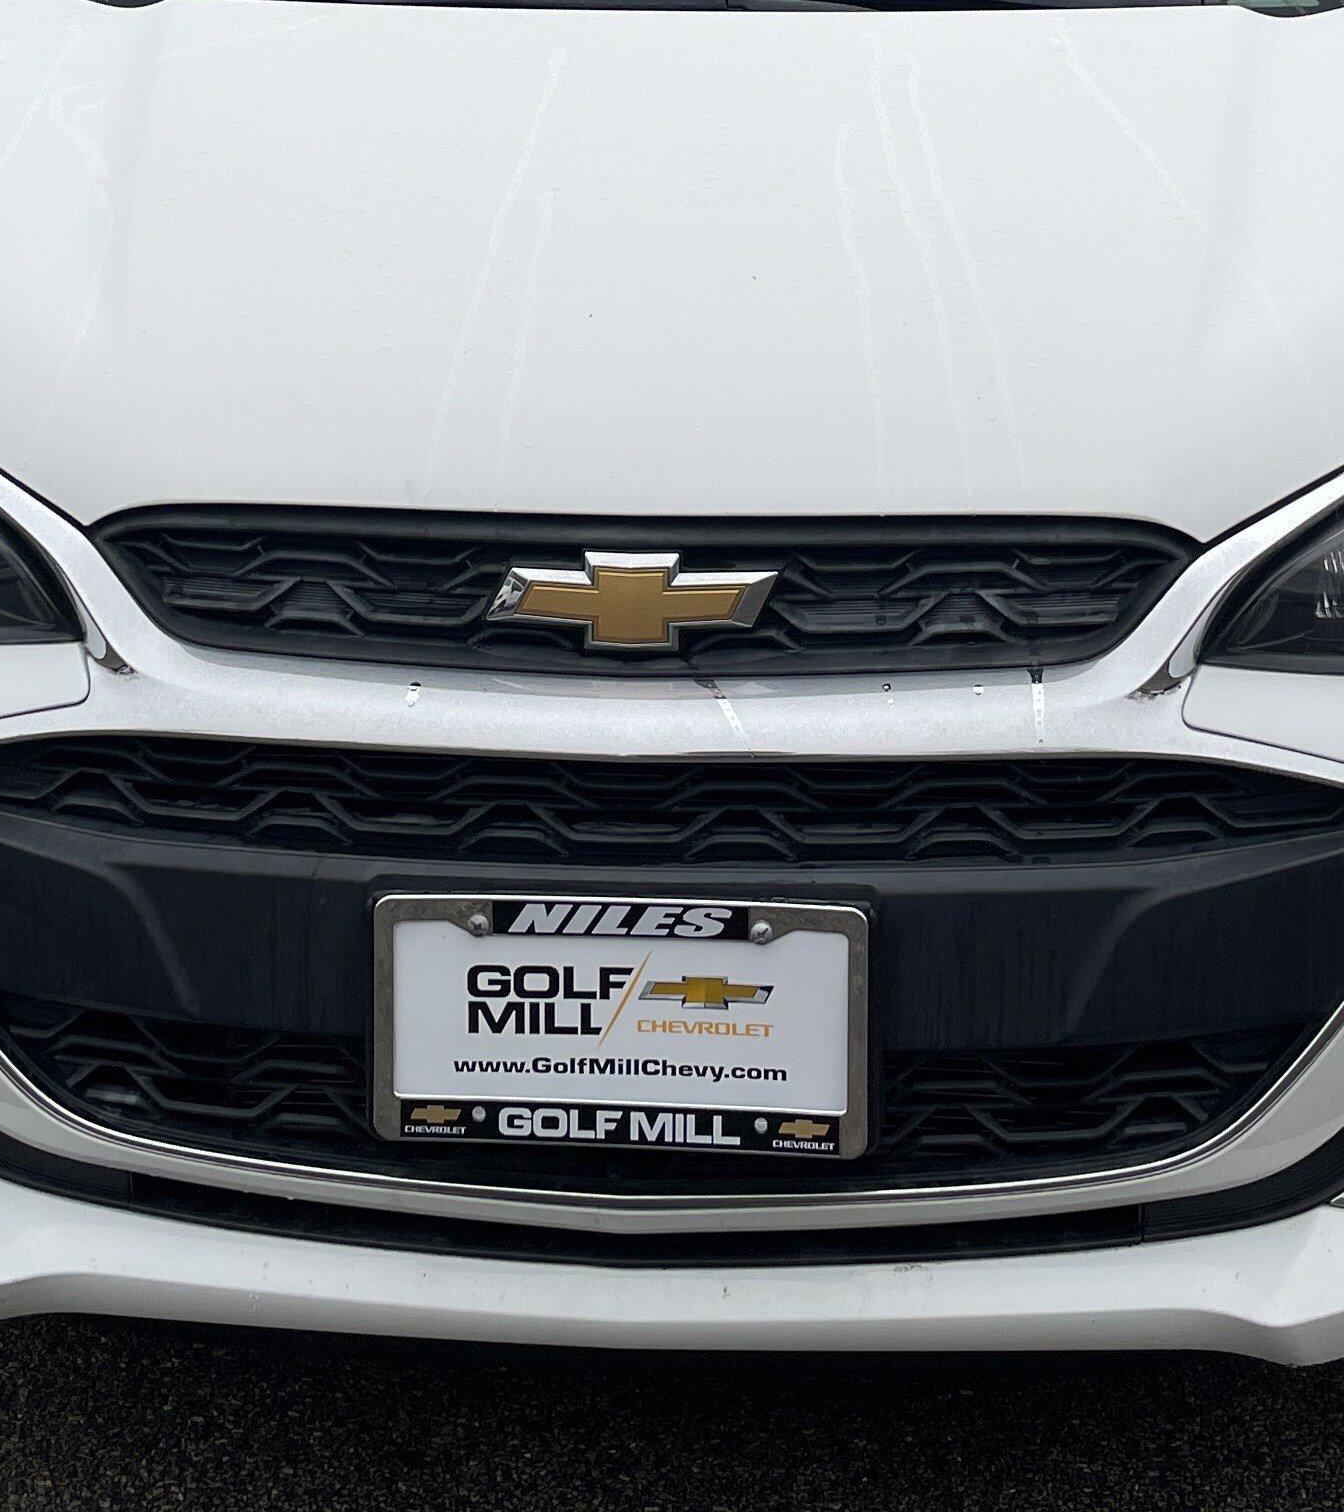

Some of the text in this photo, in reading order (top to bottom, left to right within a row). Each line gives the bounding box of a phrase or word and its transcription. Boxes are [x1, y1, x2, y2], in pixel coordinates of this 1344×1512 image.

[507, 902, 735, 938] NILES
[467, 964, 635, 1000] GOLF
[467, 1002, 603, 1036] MILL
[636, 1019, 774, 1038] CHEVROLET
[453, 1056, 788, 1082] www.GolfMillChevy.com
[404, 1124, 467, 1135] CHEVROLET
[498, 1106, 740, 1146] GOLF MILL
[772, 1139, 835, 1150] CHEVROLET
